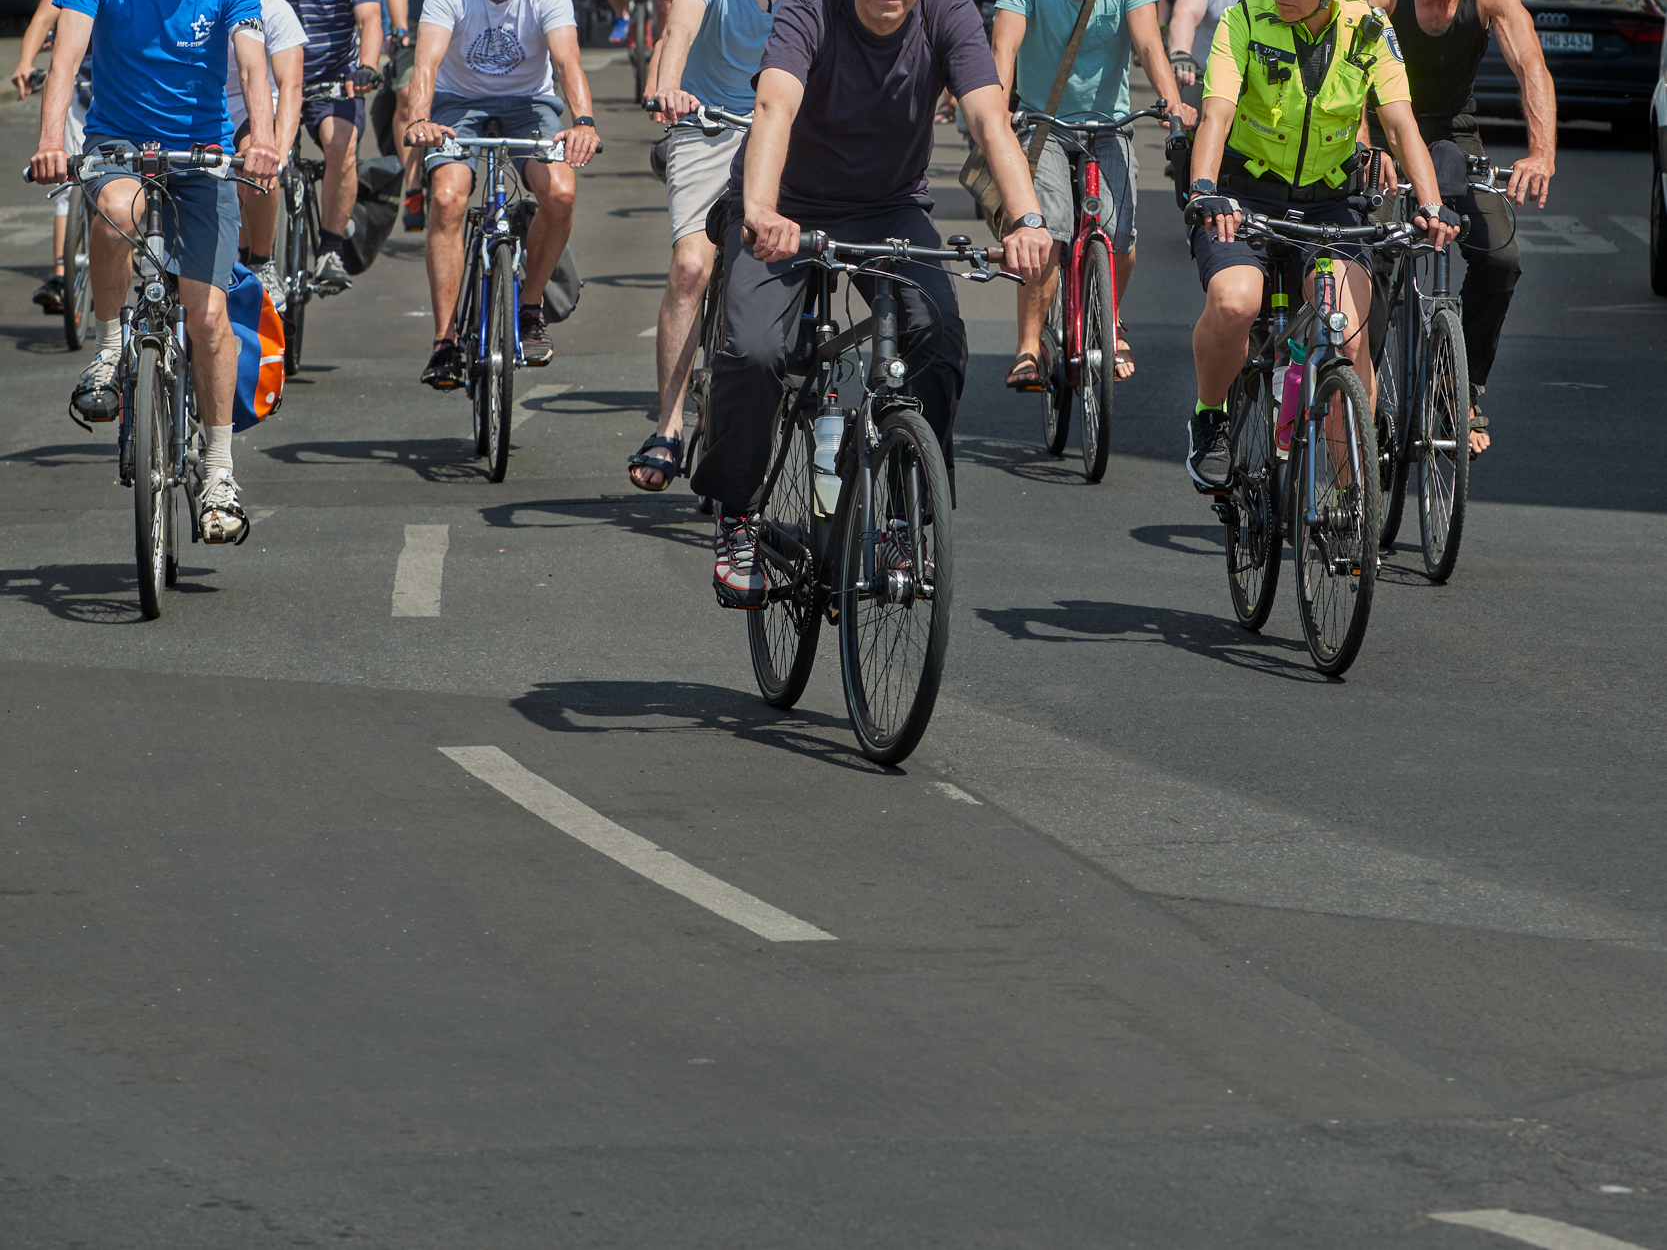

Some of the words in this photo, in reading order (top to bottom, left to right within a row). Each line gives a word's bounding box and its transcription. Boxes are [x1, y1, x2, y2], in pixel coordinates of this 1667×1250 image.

[1563, 36, 1591, 47] 3434
[1248, 117, 1275, 135] POLIZEI
[1335, 121, 1357, 138] POLIZEI
